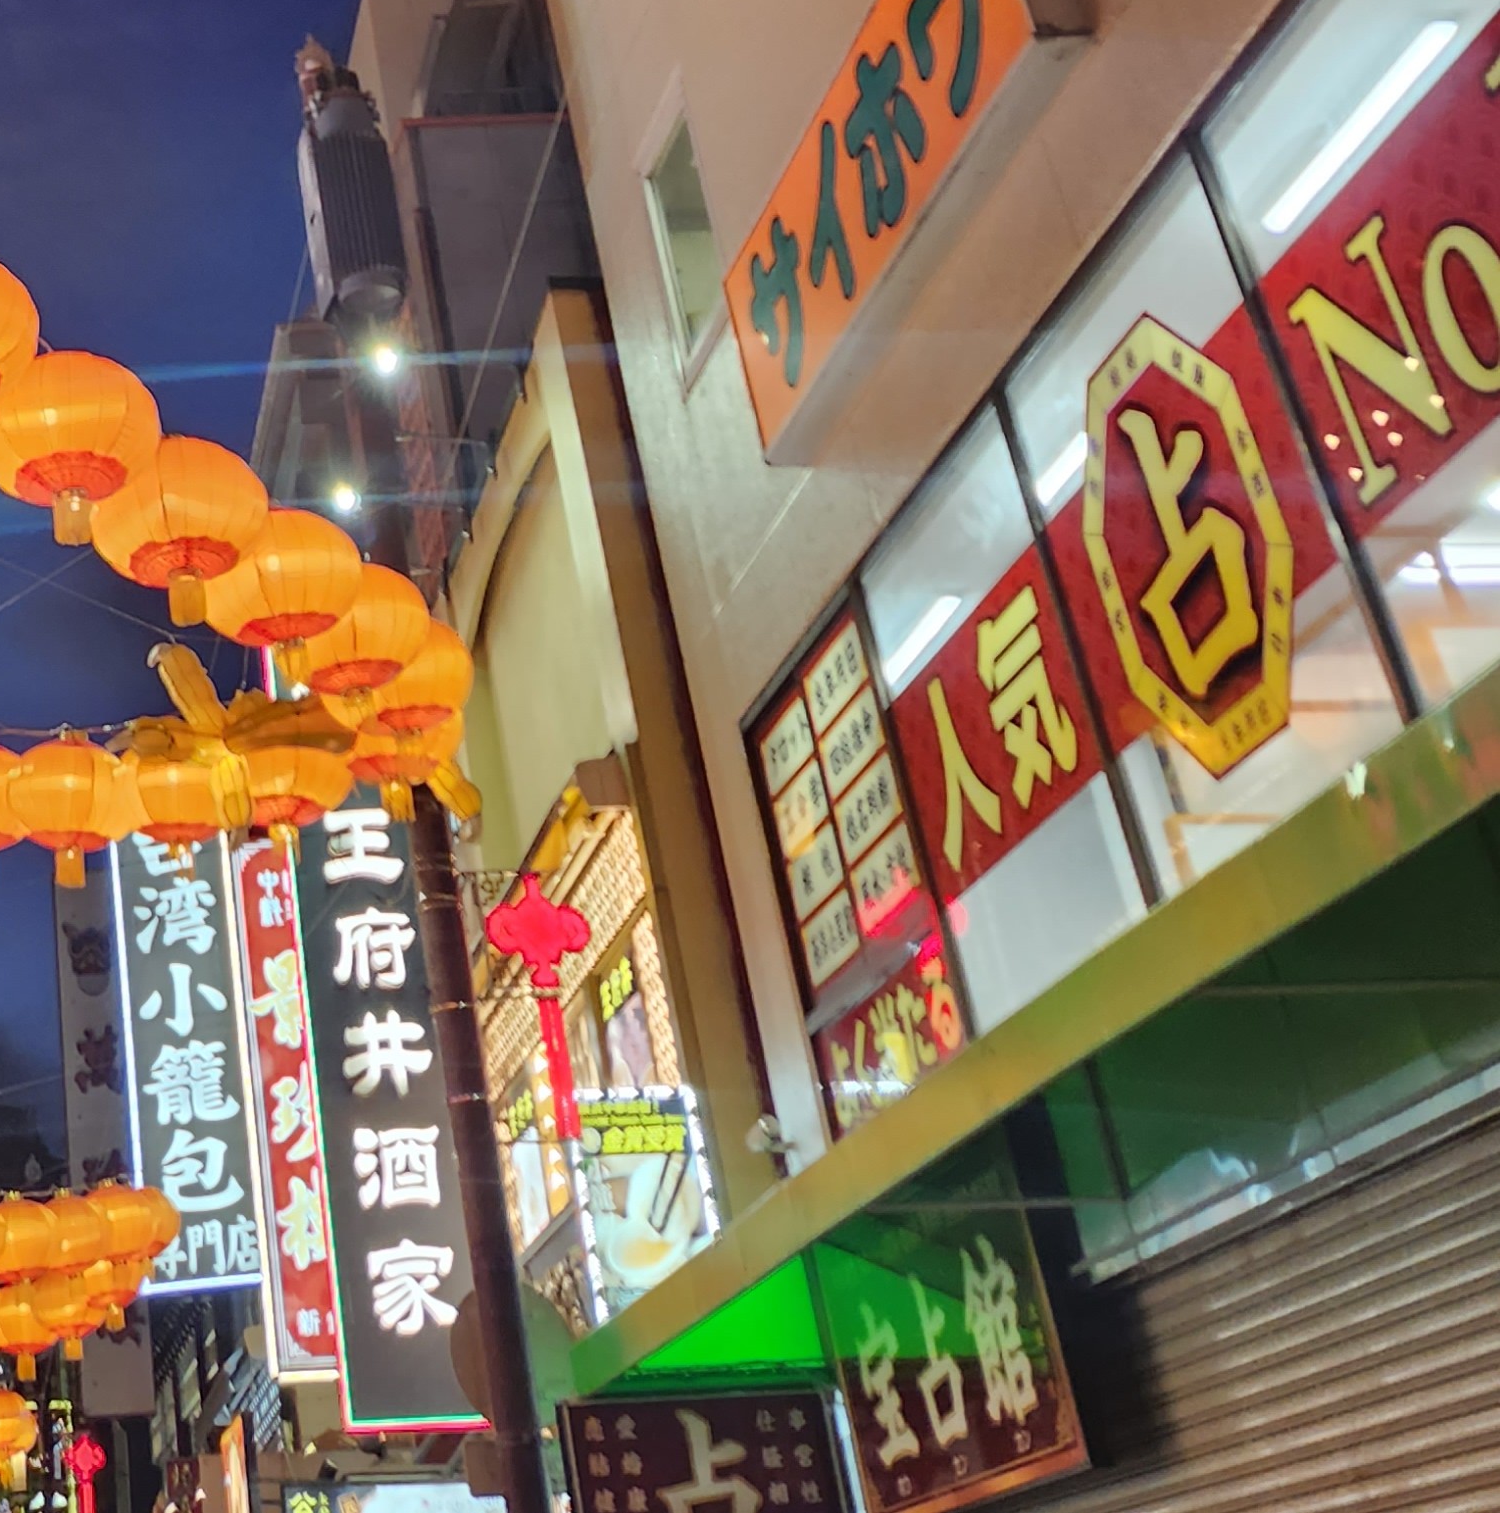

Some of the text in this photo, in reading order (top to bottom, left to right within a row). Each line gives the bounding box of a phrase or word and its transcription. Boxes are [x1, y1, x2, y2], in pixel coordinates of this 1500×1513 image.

[1116, 408, 1260, 701] 占
[926, 585, 1077, 872] 人気
[323, 808, 460, 1334] 王府井酒家
